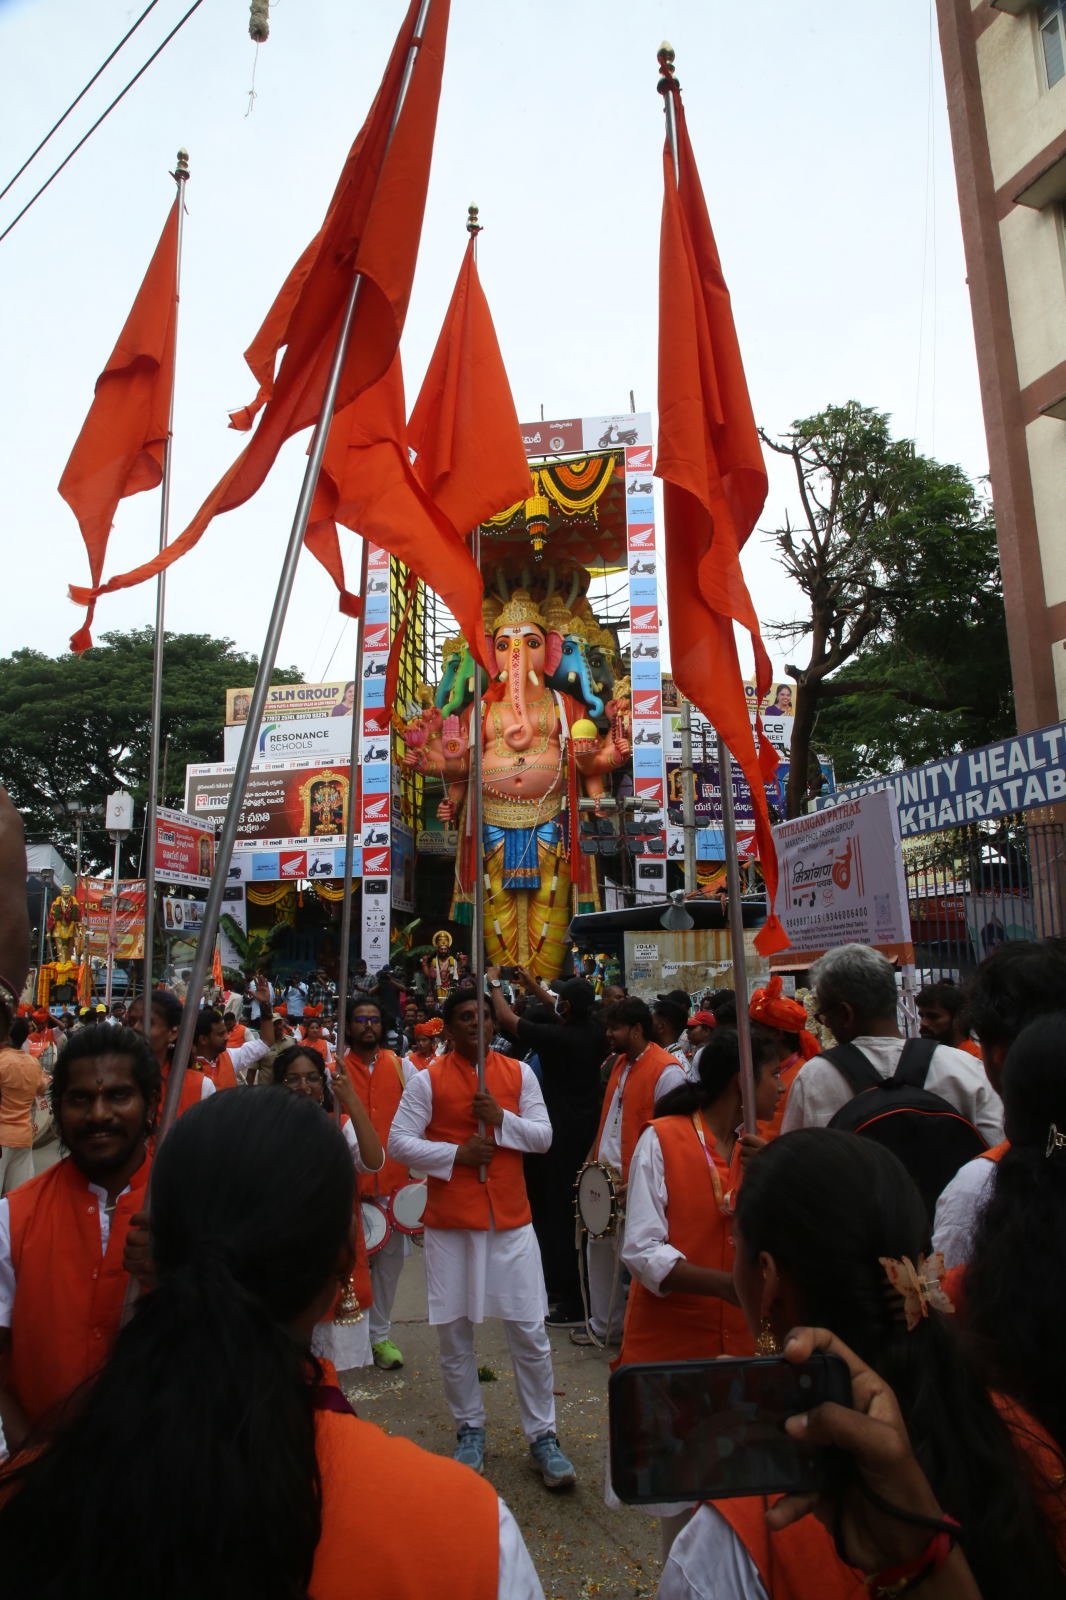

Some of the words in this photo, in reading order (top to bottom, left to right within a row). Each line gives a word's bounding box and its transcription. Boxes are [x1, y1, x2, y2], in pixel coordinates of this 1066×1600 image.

[271, 690, 295, 702] SLN
[297, 687, 340, 701] GROUP
[270, 730, 329, 743] RESONANCE
[270, 741, 313, 752] SCHOOLS
[968, 726, 1066, 786] HEALT
